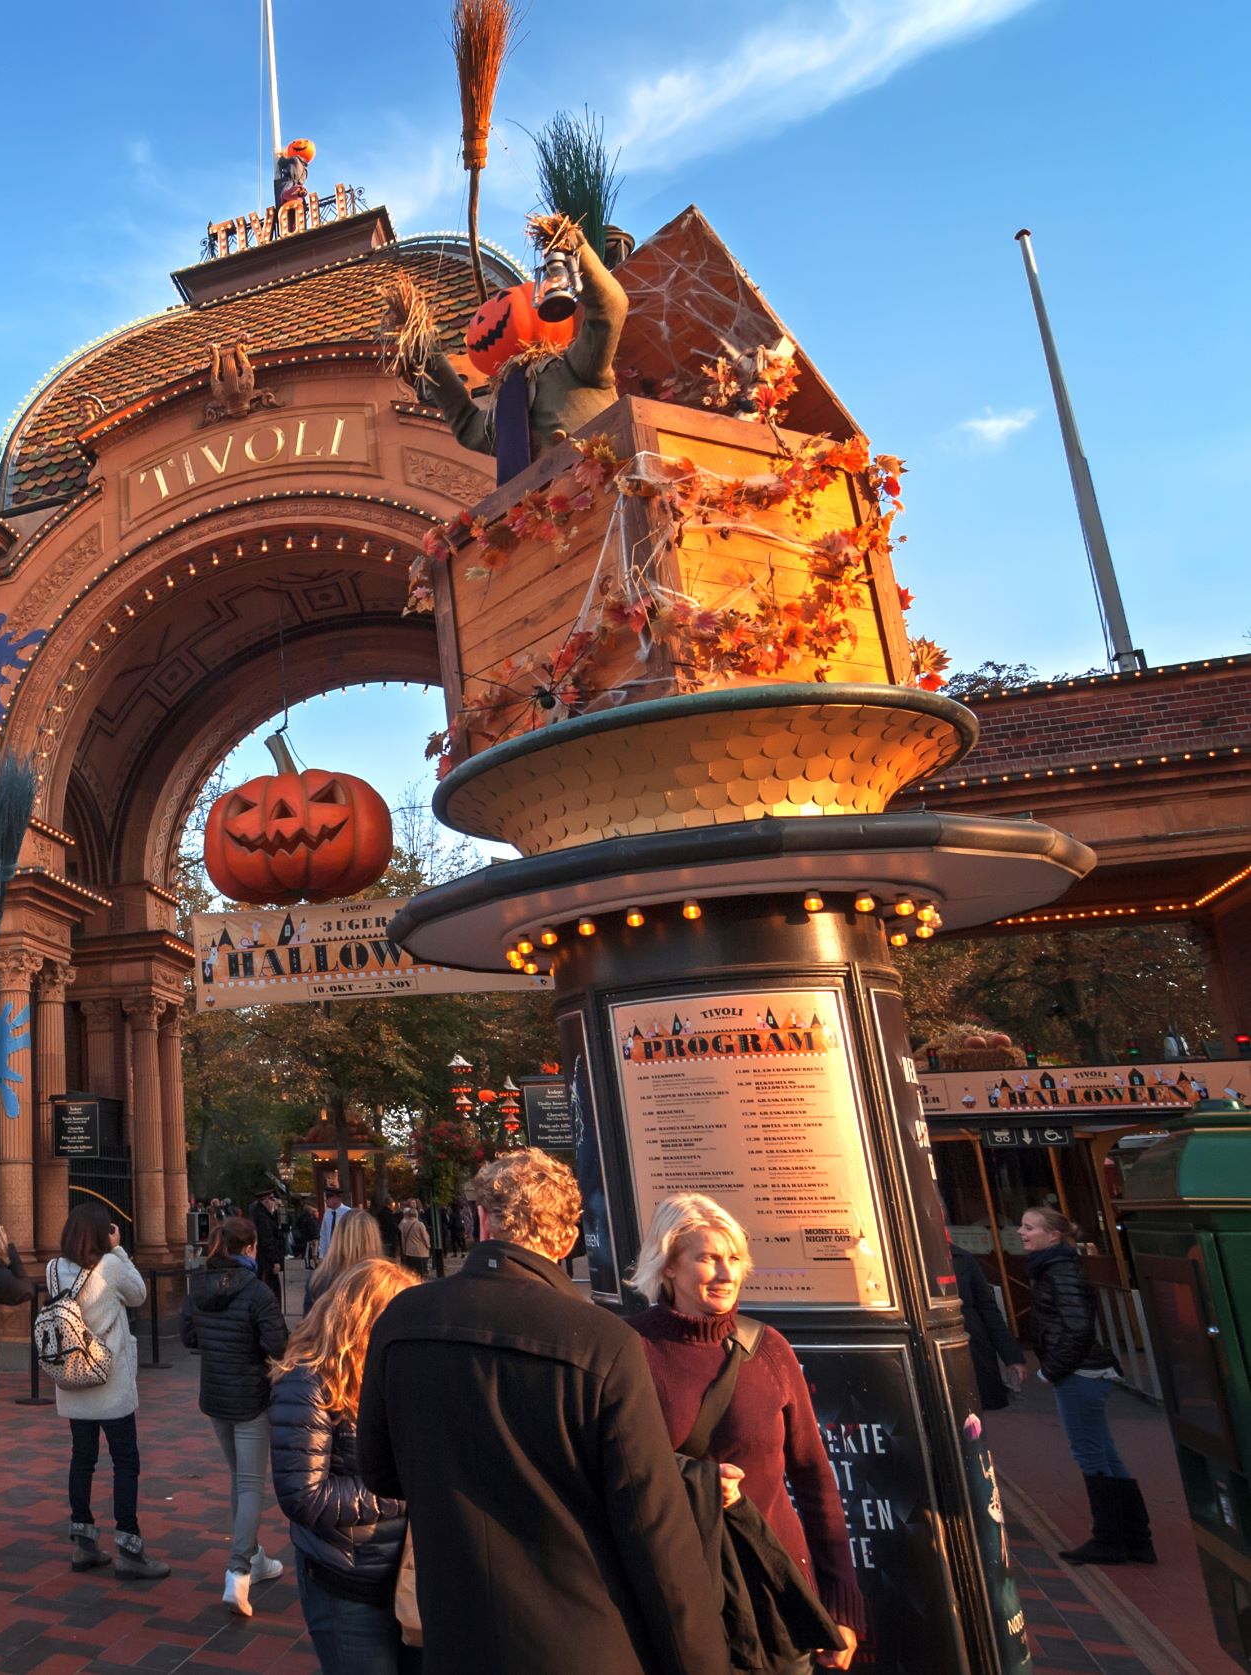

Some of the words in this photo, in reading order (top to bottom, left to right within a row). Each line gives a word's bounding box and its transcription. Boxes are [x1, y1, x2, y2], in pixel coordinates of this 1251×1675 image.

[209, 183, 347, 258] TIVOLI
[139, 417, 346, 499] TIVOLI
[340, 904, 372, 912] TIVOLI
[322, 921, 333, 932] 3
[336, 917, 388, 931] UGER
[227, 938, 432, 979] HALLOW
[312, 983, 354, 994] 10.OKT
[375, 980, 413, 991] 2.NOV
[700, 1008, 743, 1019] TIVOLI
[644, 1031, 814, 1059] PROGRAM
[1074, 1071, 1108, 1079] TIVOLI
[1007, 1084, 1192, 1106] HALLOWEEN
[849, 1537, 875, 1568] TE
